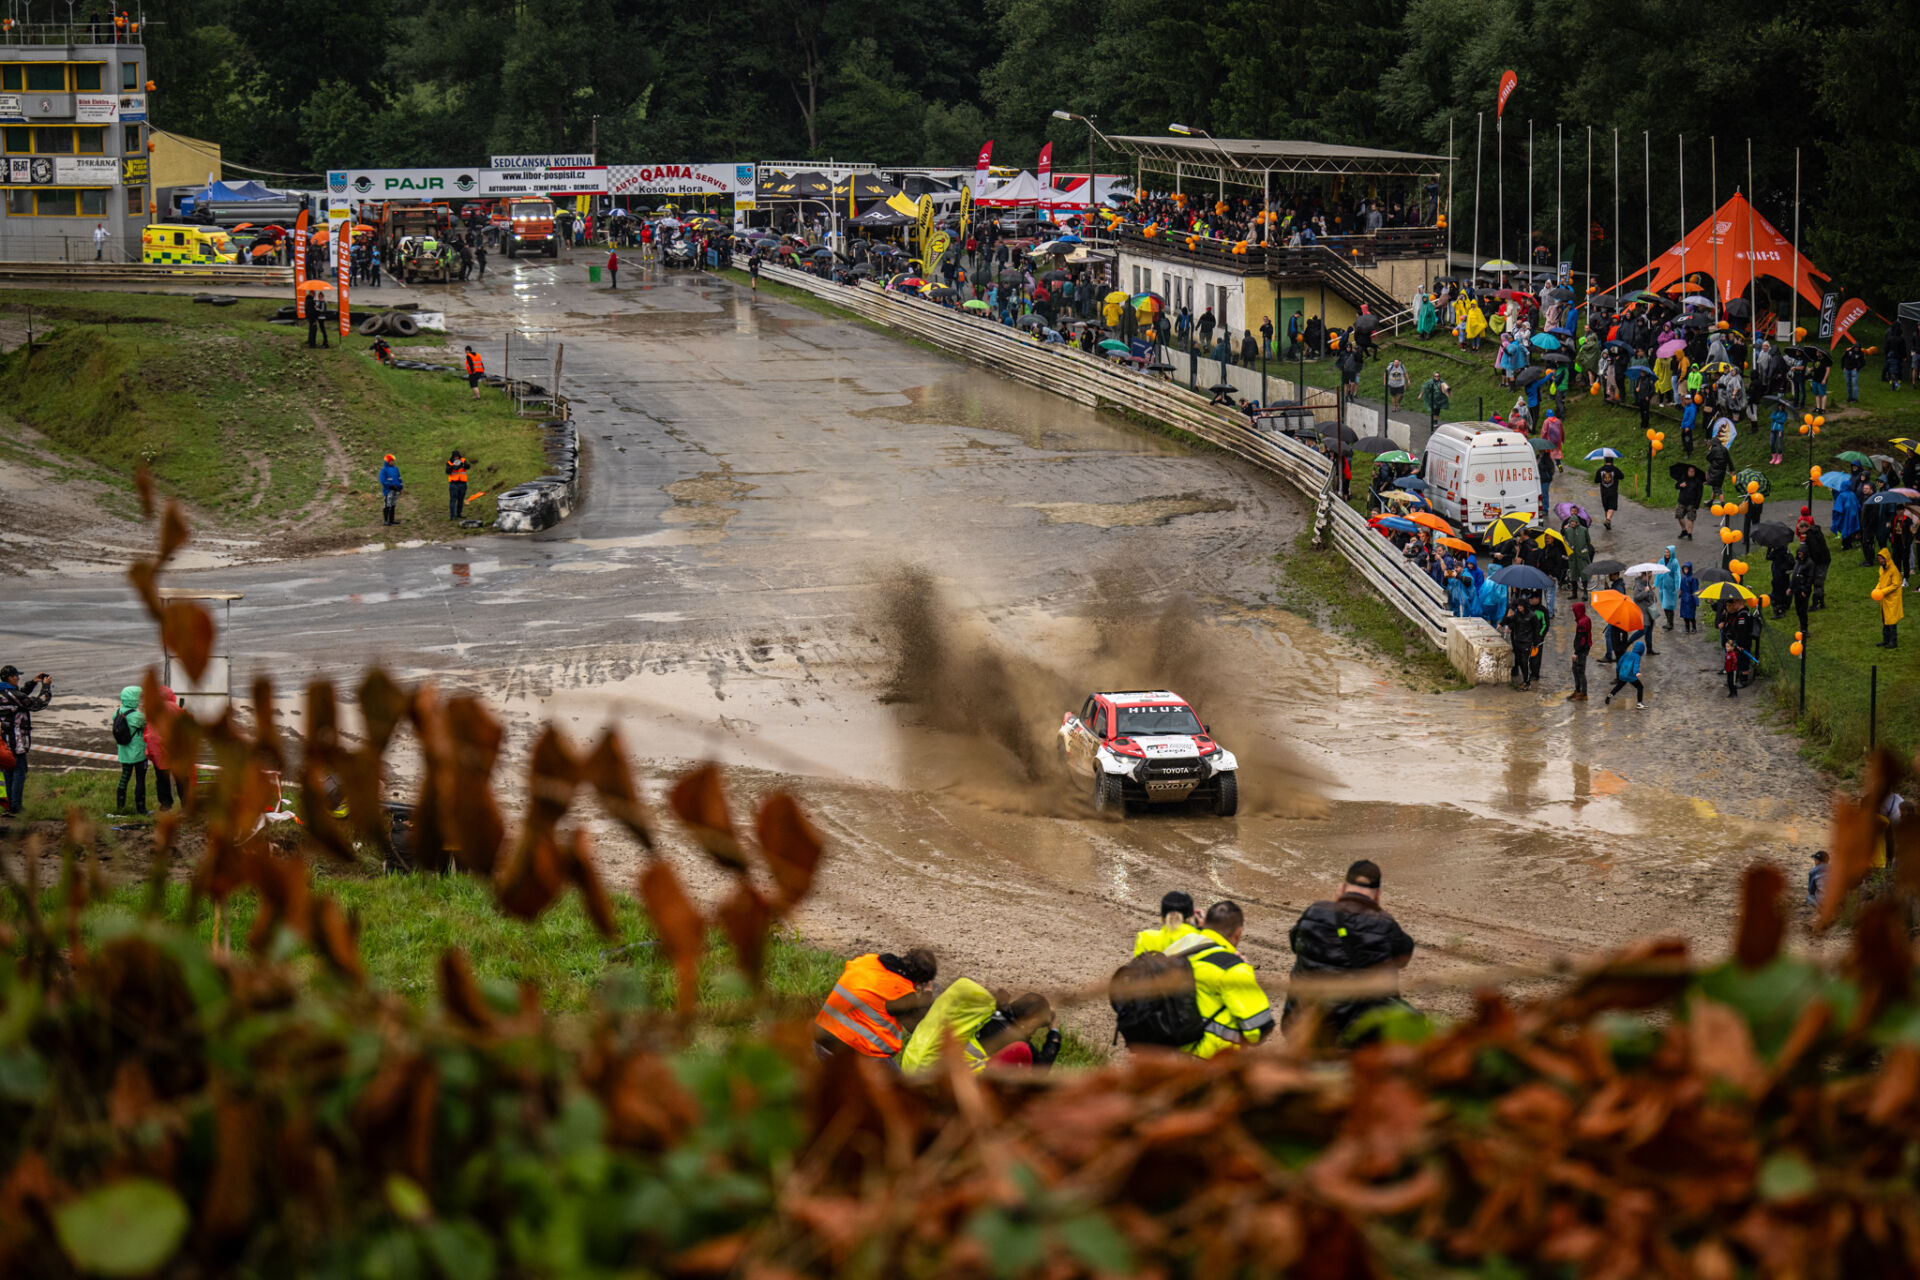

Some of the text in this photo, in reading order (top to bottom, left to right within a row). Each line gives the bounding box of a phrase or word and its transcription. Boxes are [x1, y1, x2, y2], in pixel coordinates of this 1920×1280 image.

[76, 158, 116, 167] TISKÁRNA
[494, 156, 593, 168] SEDLČANSKÁ KOTLINA
[502, 171, 585, 180] www.libor-pospisil.cz
[640, 165, 693, 182] QAMA
[384, 177, 444, 190] PAJR
[550, 183, 567, 191] PRÁCE
[615, 176, 638, 193] AUTO
[695, 172, 727, 191] SERVIS
[639, 184, 703, 193] Kosova Hora
[961, 192, 969, 220] Nikon
[920, 199, 931, 230] Nikon
